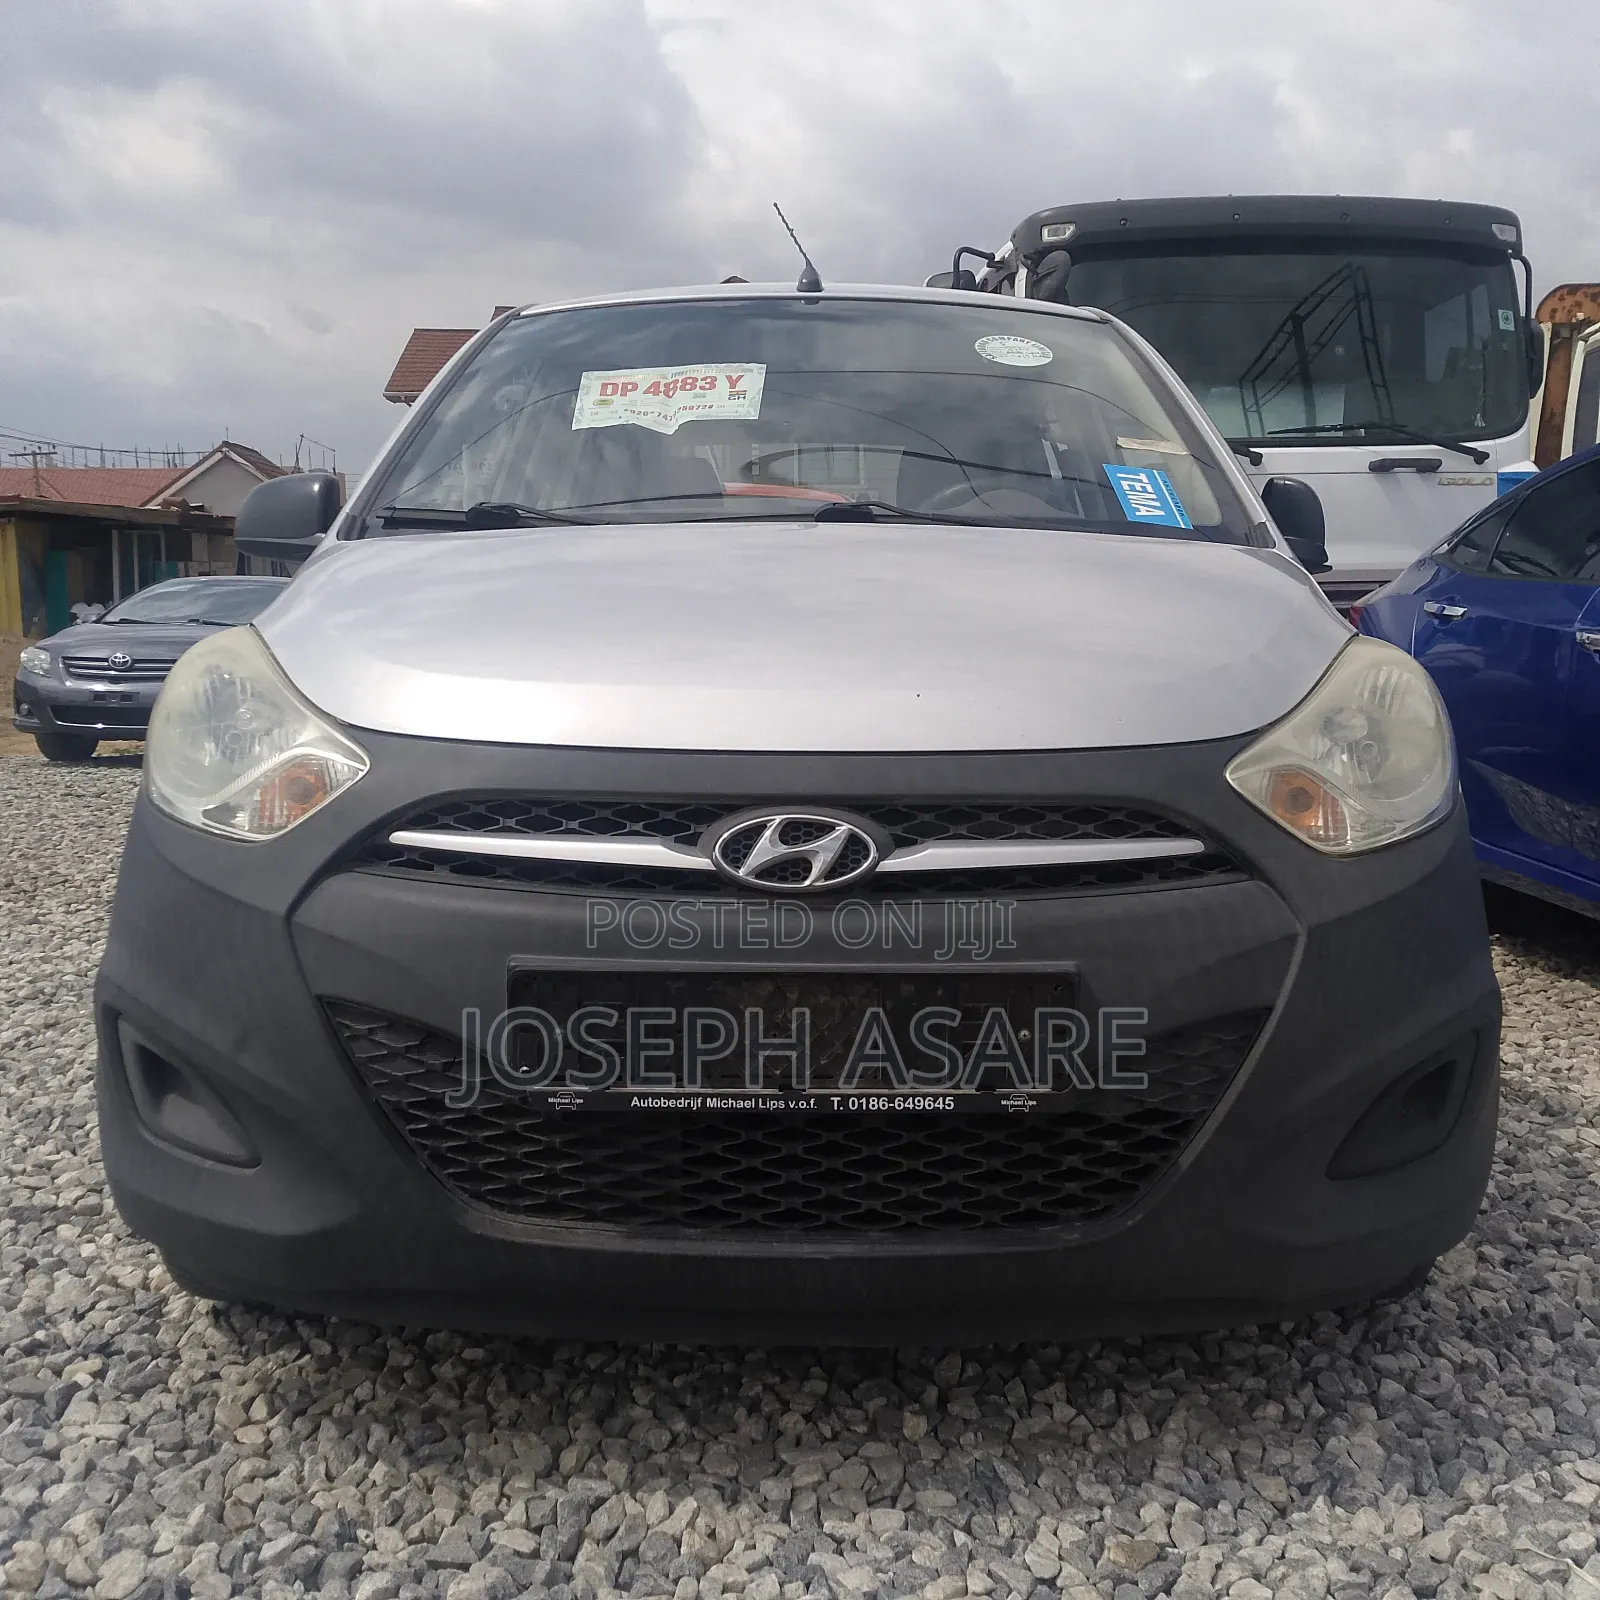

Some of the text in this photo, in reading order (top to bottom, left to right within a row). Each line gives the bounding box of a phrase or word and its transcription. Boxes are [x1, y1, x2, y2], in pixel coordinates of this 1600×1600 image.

[599, 382, 639, 397] DP
[724, 374, 745, 390] Y
[1116, 472, 1166, 516] TEMA
[571, 1097, 584, 1105] Lips
[630, 1096, 955, 1111] Autobedrijf Michael Lips v.o.f. T. 0186-649645
[1024, 1099, 1037, 1107] Lips
